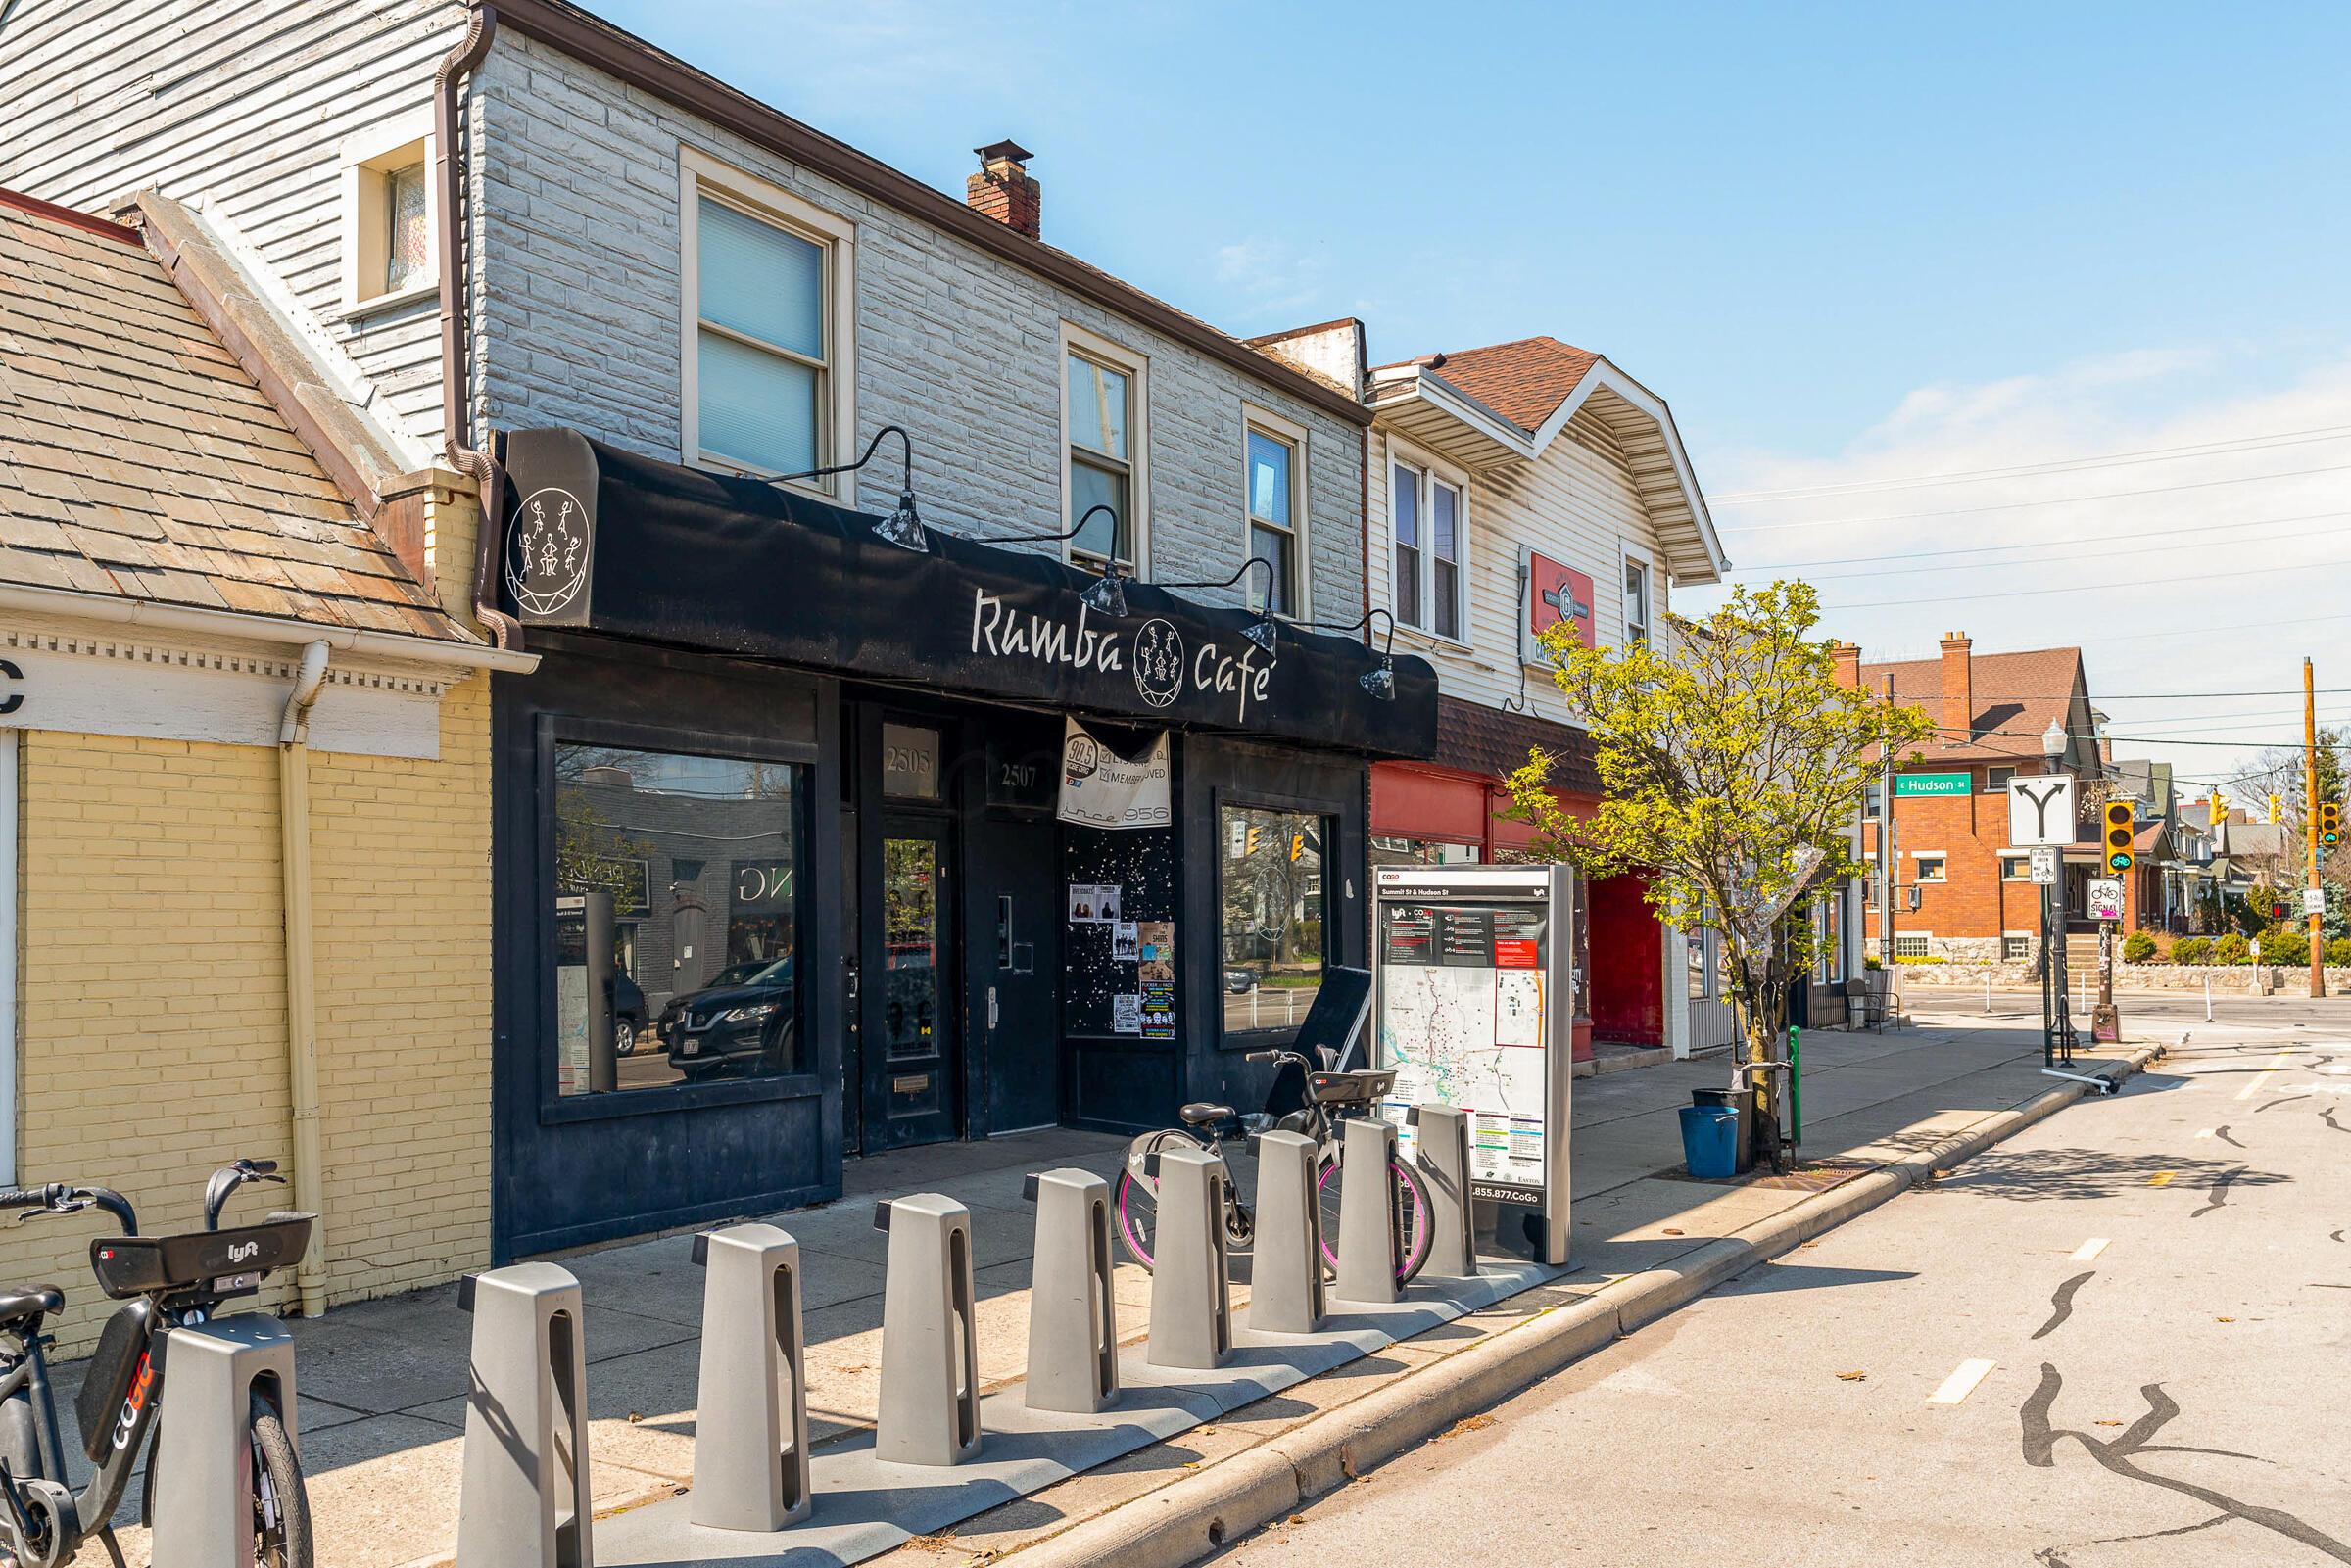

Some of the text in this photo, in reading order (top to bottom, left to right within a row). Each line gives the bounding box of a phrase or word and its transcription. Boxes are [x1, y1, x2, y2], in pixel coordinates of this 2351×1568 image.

[972, 588, 1277, 723] Rumba Café
[888, 746, 931, 774] 2505
[1069, 740, 1094, 765] 90.5
[1002, 763, 1037, 787] 2507
[1908, 780, 1954, 791] Hudson
[1391, 907, 1406, 920] lyft
[1129, 1152, 1144, 1166] lyft
[228, 1241, 258, 1262] lyft
